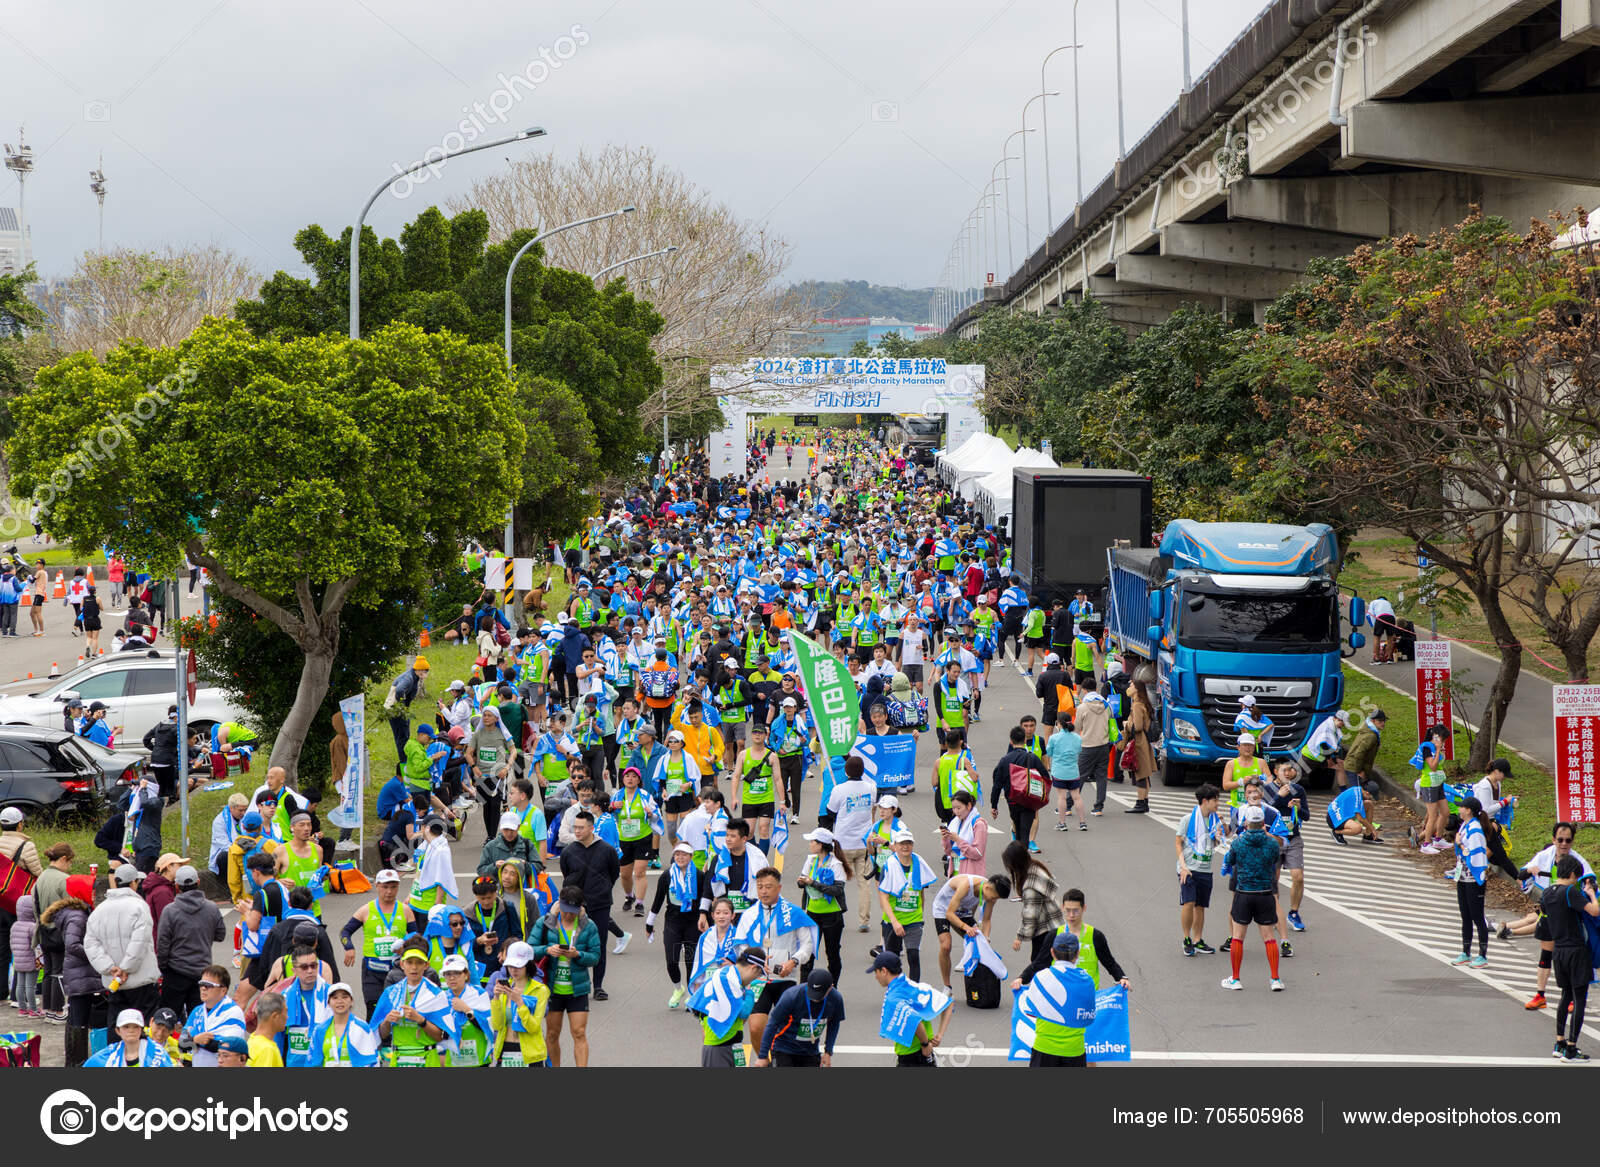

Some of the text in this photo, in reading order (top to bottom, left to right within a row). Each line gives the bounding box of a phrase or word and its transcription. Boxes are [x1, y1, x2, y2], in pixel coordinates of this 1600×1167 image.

[869, 376, 900, 387] Charity
[902, 377, 945, 385] Marathon
[814, 391, 881, 408] FINISH
[1240, 685, 1277, 693] DAF
[1566, 717, 1582, 822] 禁止停放加強拖吊
[1581, 716, 1597, 822] 本路段停車格位取消
[883, 773, 912, 782] Finisher
[1085, 1040, 1127, 1054] inisher
